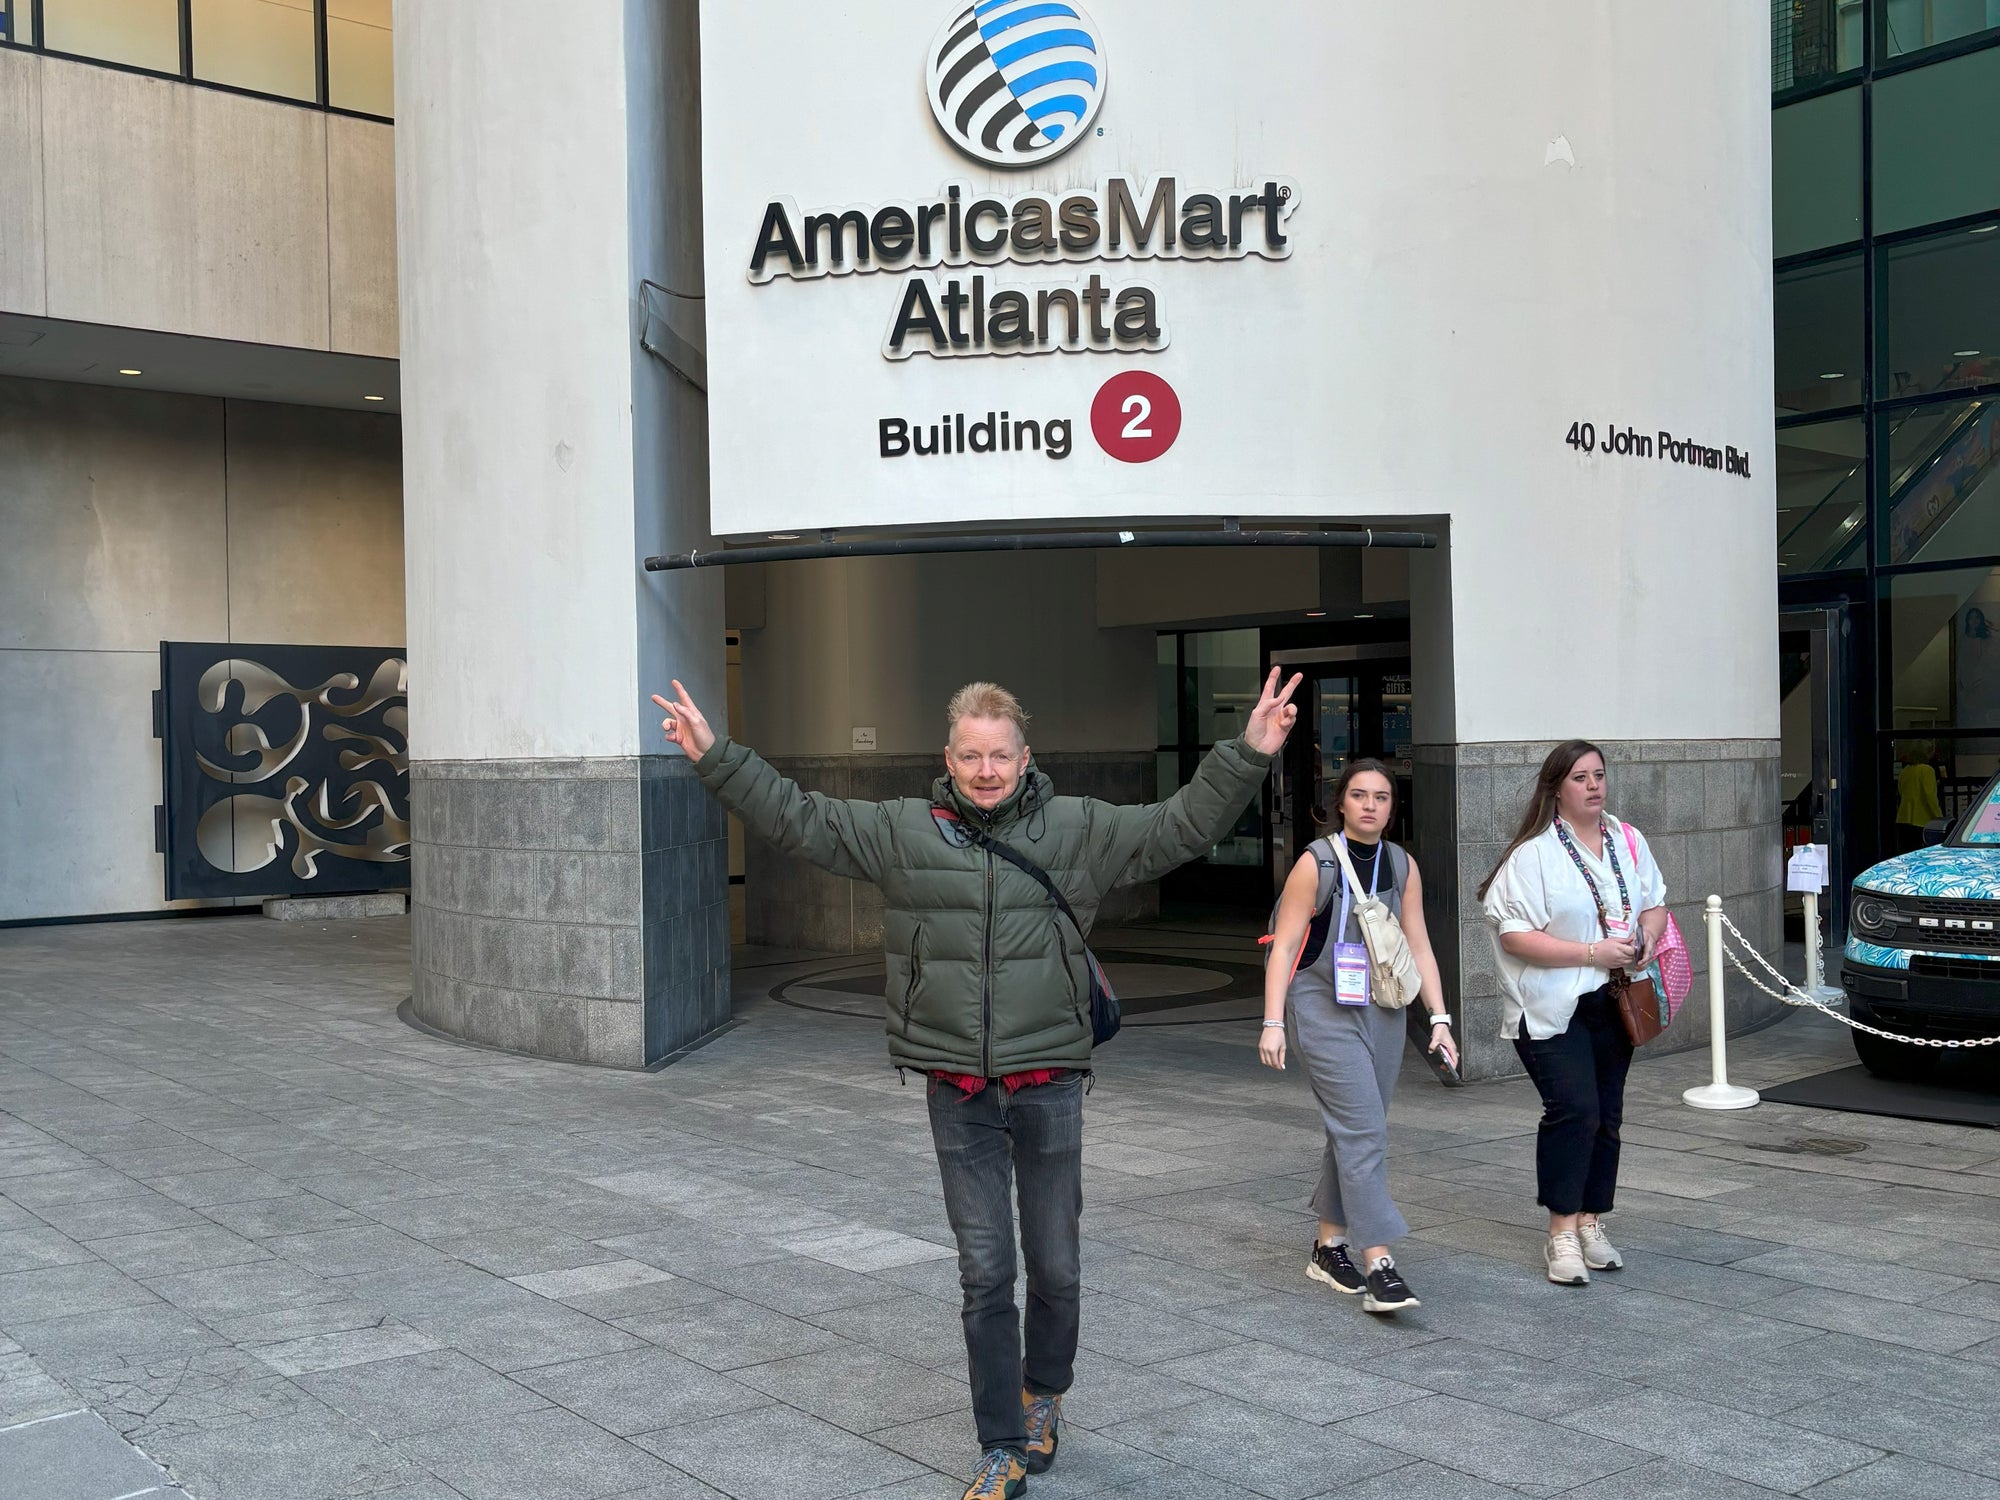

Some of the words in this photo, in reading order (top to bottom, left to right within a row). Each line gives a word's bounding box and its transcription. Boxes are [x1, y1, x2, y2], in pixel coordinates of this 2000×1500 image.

[889, 274, 1161, 345] Atlanta
[878, 411, 1073, 459] Building
[1120, 394, 1153, 438] 2
[1565, 421, 1596, 452] 40
[1601, 424, 1653, 458] John
[1658, 431, 1723, 471] Portman
[1725, 445, 1751, 478] Blvd.
[1386, 682, 1406, 694] GIFTS
